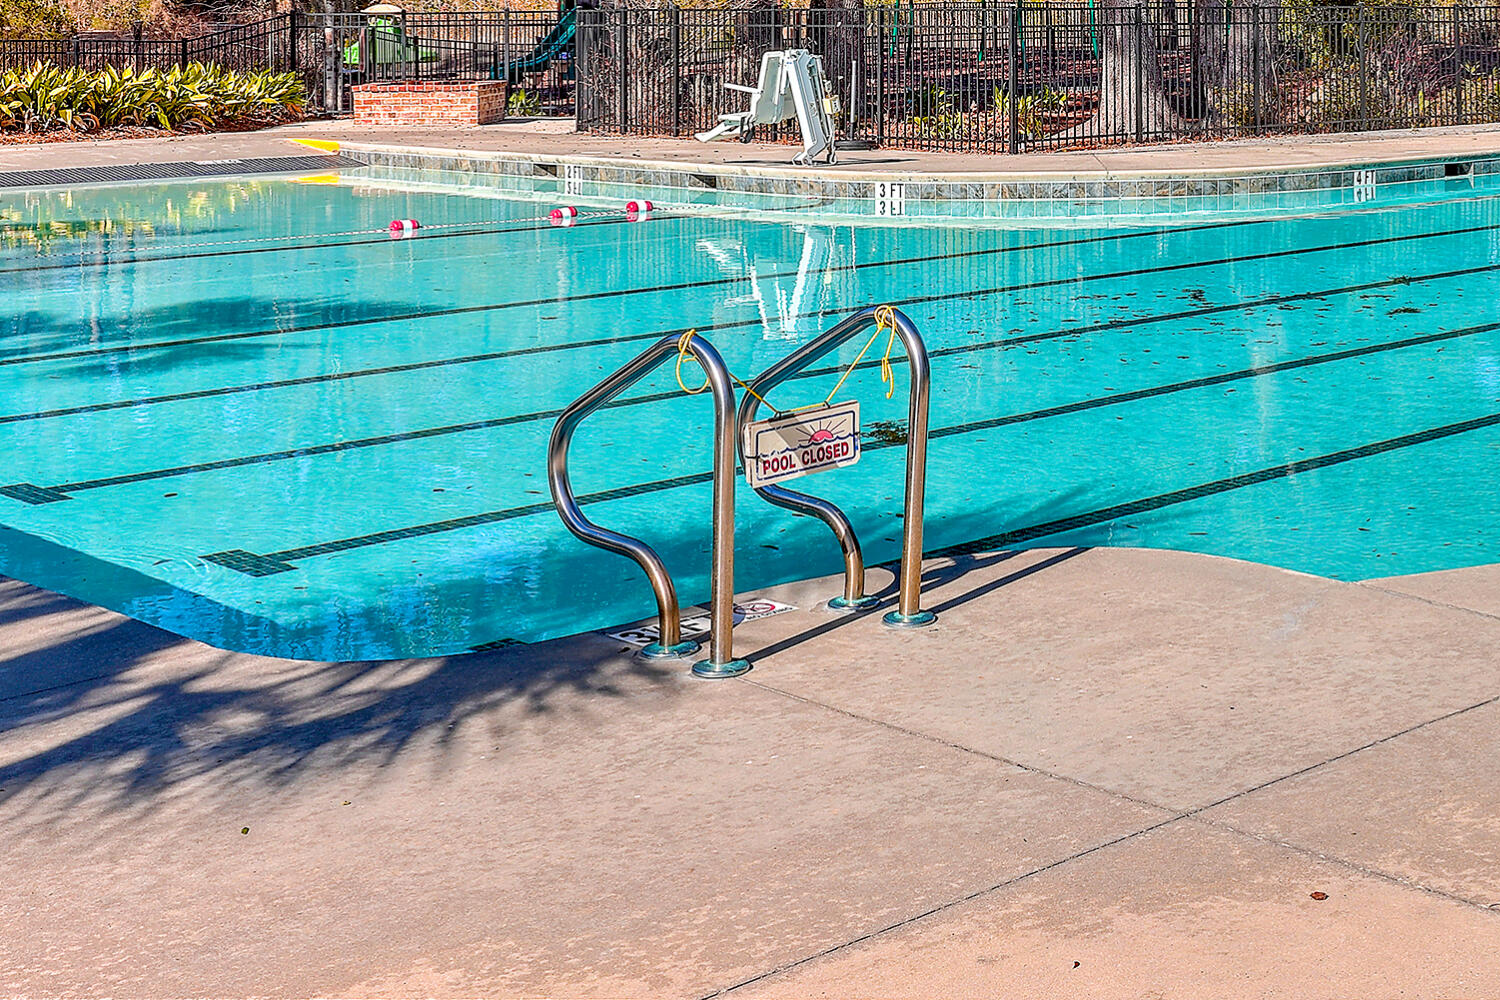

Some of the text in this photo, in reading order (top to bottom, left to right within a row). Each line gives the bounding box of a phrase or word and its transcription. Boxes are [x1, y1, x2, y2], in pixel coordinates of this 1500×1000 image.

[1365, 169, 1376, 184] FT
[879, 183, 905, 198] 3 FT
[762, 442, 850, 475] POOL CLOSED
